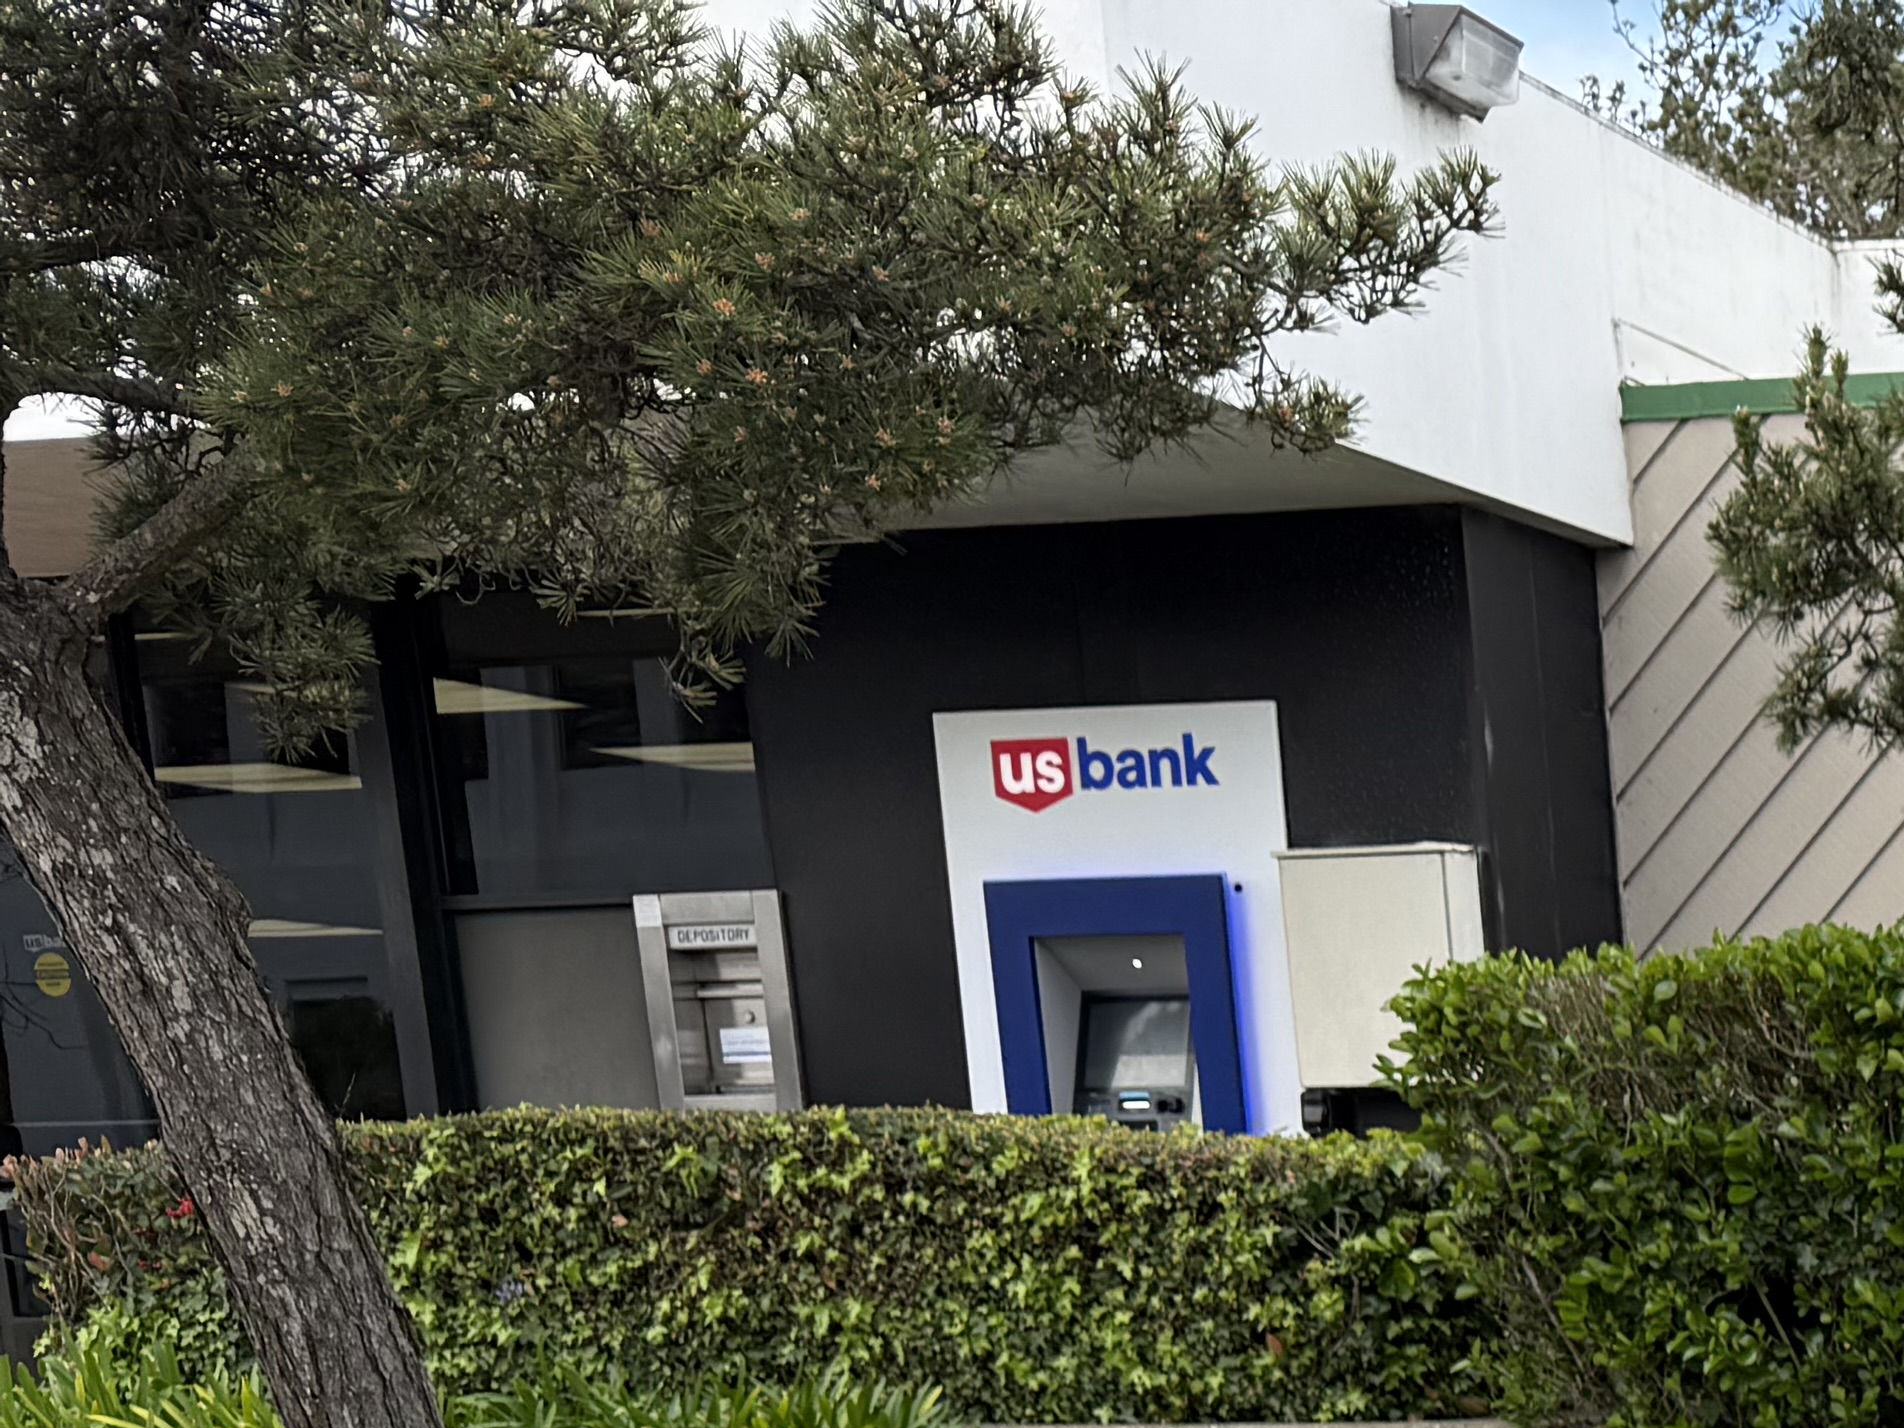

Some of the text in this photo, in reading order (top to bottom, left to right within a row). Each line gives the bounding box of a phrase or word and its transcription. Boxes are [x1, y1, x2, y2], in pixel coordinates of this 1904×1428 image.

[999, 733, 1220, 795] us bank
[677, 927, 750, 943] DEPOSITORY
